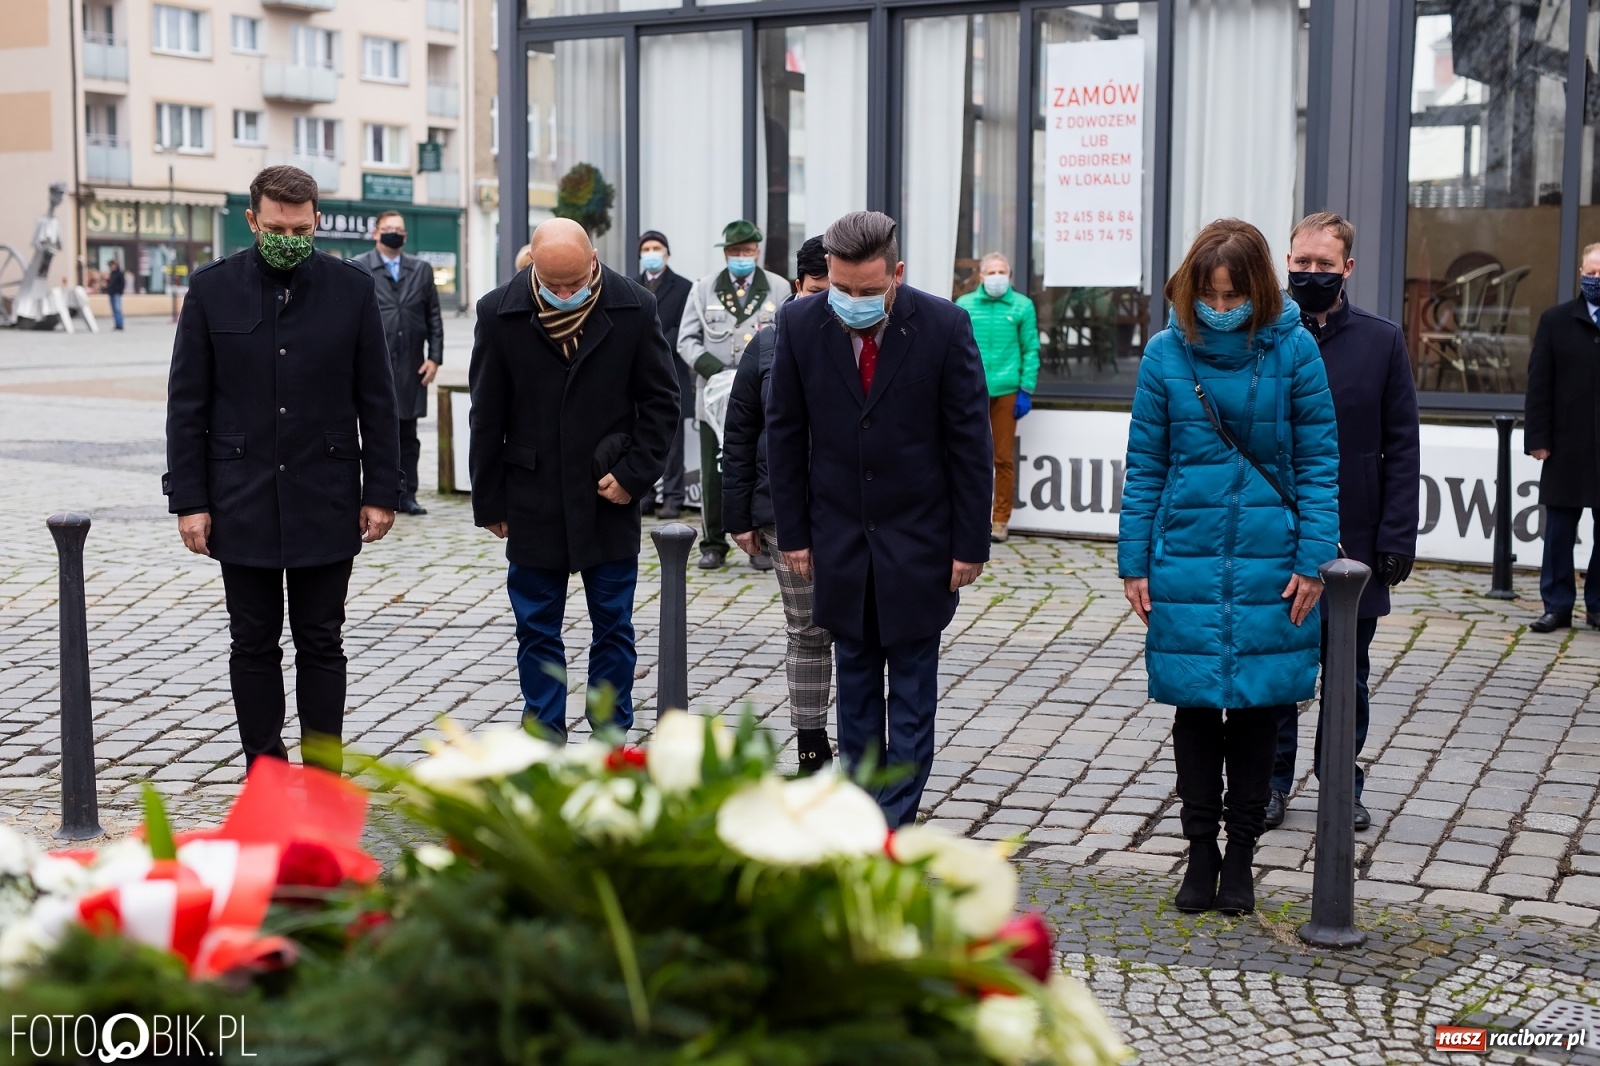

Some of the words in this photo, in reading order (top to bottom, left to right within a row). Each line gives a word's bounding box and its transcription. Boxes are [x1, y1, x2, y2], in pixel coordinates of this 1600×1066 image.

[1053, 78, 1139, 107] ZAMÓW
[1055, 116, 1063, 129] Z
[1067, 114, 1136, 129] DOWOZEM
[1081, 134, 1109, 148] LUB
[1059, 153, 1131, 167] ODBIOREM
[1059, 174, 1070, 186] W
[1075, 172, 1131, 186] LOKALU
[87, 202, 186, 235] STELLA
[1055, 211, 1069, 223] 32
[1073, 211, 1093, 223] 415
[1098, 210, 1114, 222] 84
[1118, 210, 1134, 222] 84
[1056, 229, 1070, 242] 32
[1074, 229, 1094, 241] 415
[1098, 229, 1114, 241] 74
[1118, 229, 1133, 241] 75
[1418, 473, 1582, 544] owa
